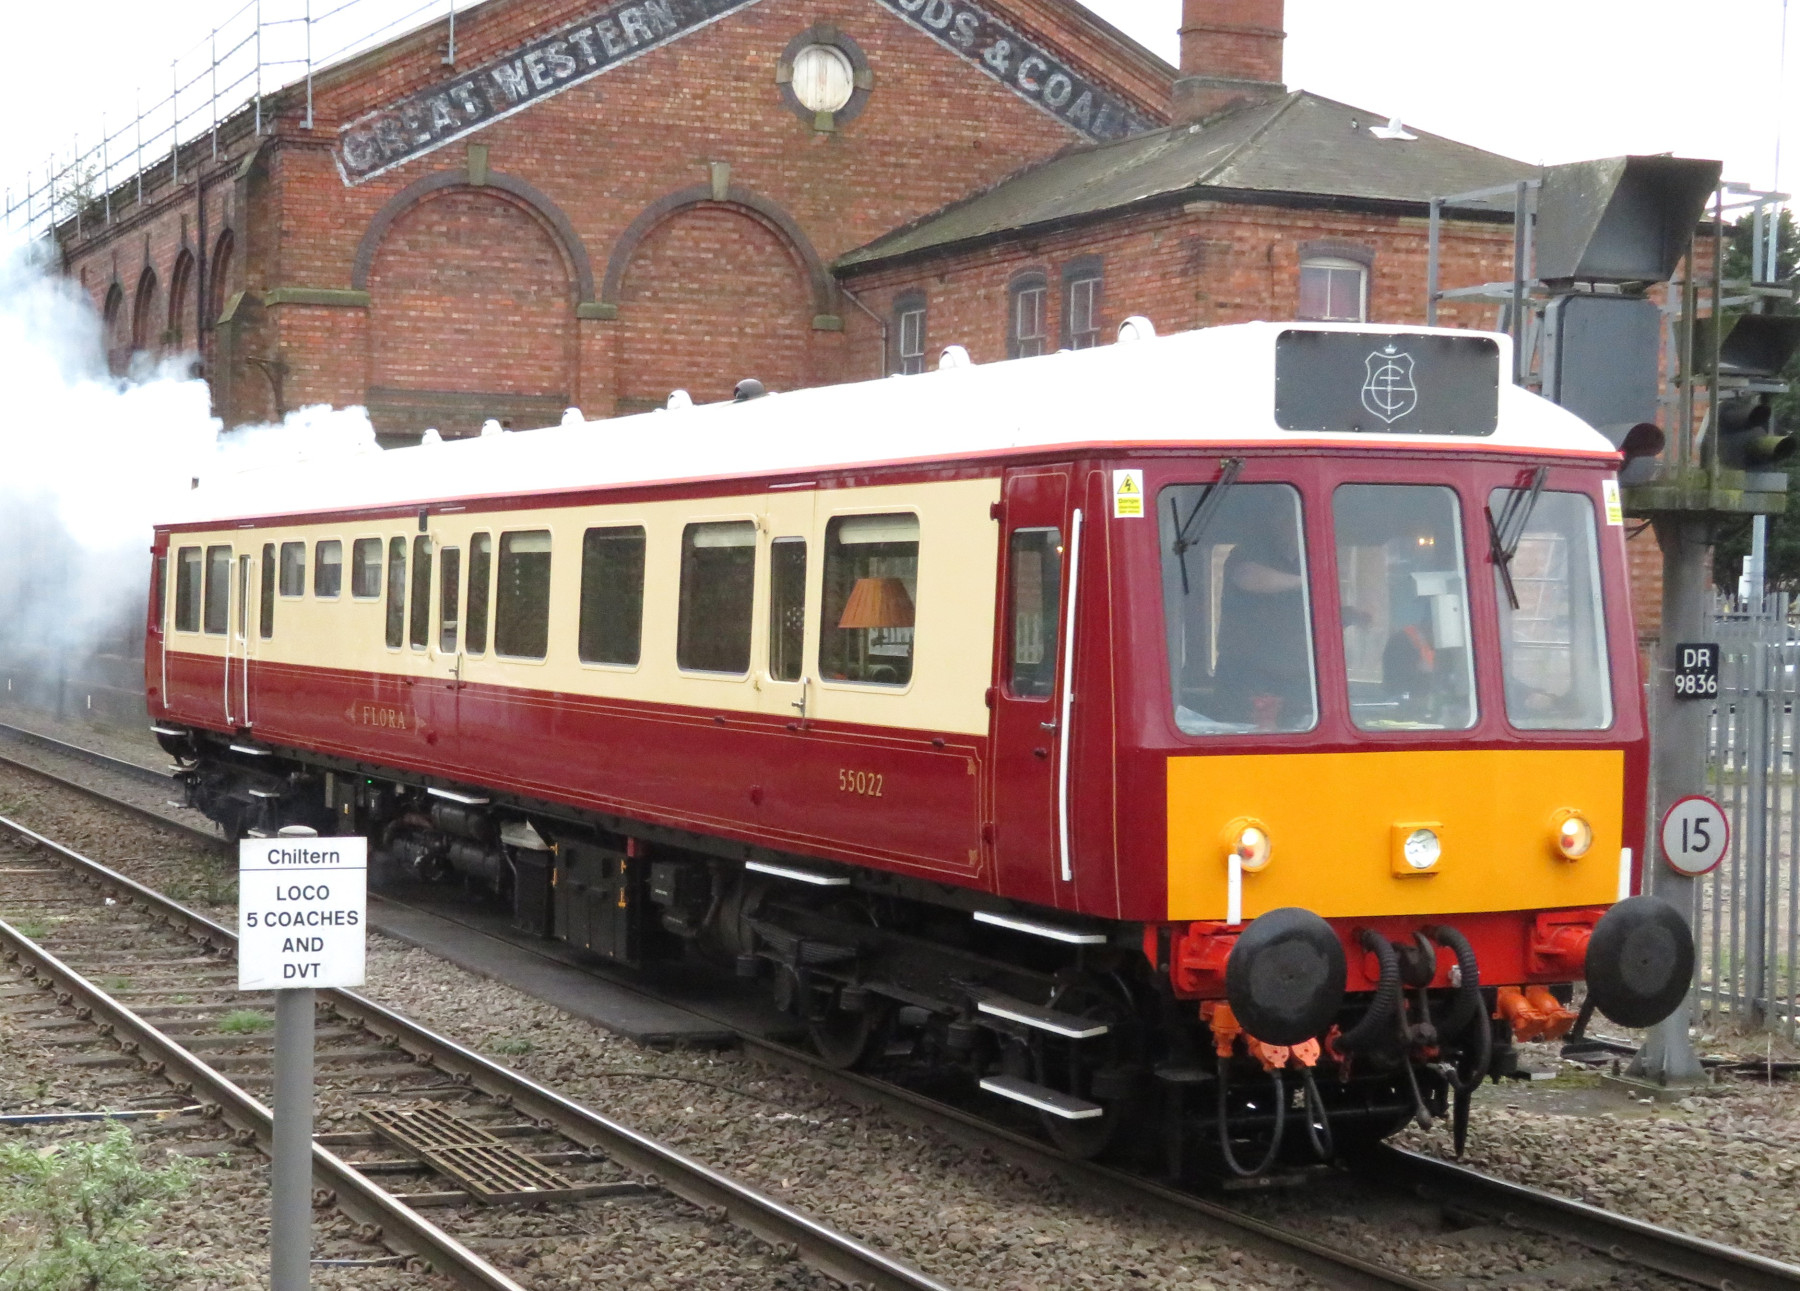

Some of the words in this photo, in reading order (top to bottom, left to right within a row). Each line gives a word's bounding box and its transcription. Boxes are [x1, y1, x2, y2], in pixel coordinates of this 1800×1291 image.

[491, 0, 677, 101] WESTERN
[984, 40, 1011, 73] &
[1683, 648, 1710, 668] DR
[1674, 674, 1718, 694] 9836
[363, 706, 406, 729] FLORA
[839, 768, 883, 797] 55022
[1682, 817, 1711, 853] 15
[267, 849, 340, 865] Chiltern
[276, 885, 330, 901] LOCO
[247, 912, 258, 927] 5
[264, 910, 359, 927] COACHES
[282, 937, 324, 952] AND
[283, 963, 321, 979] DVT
